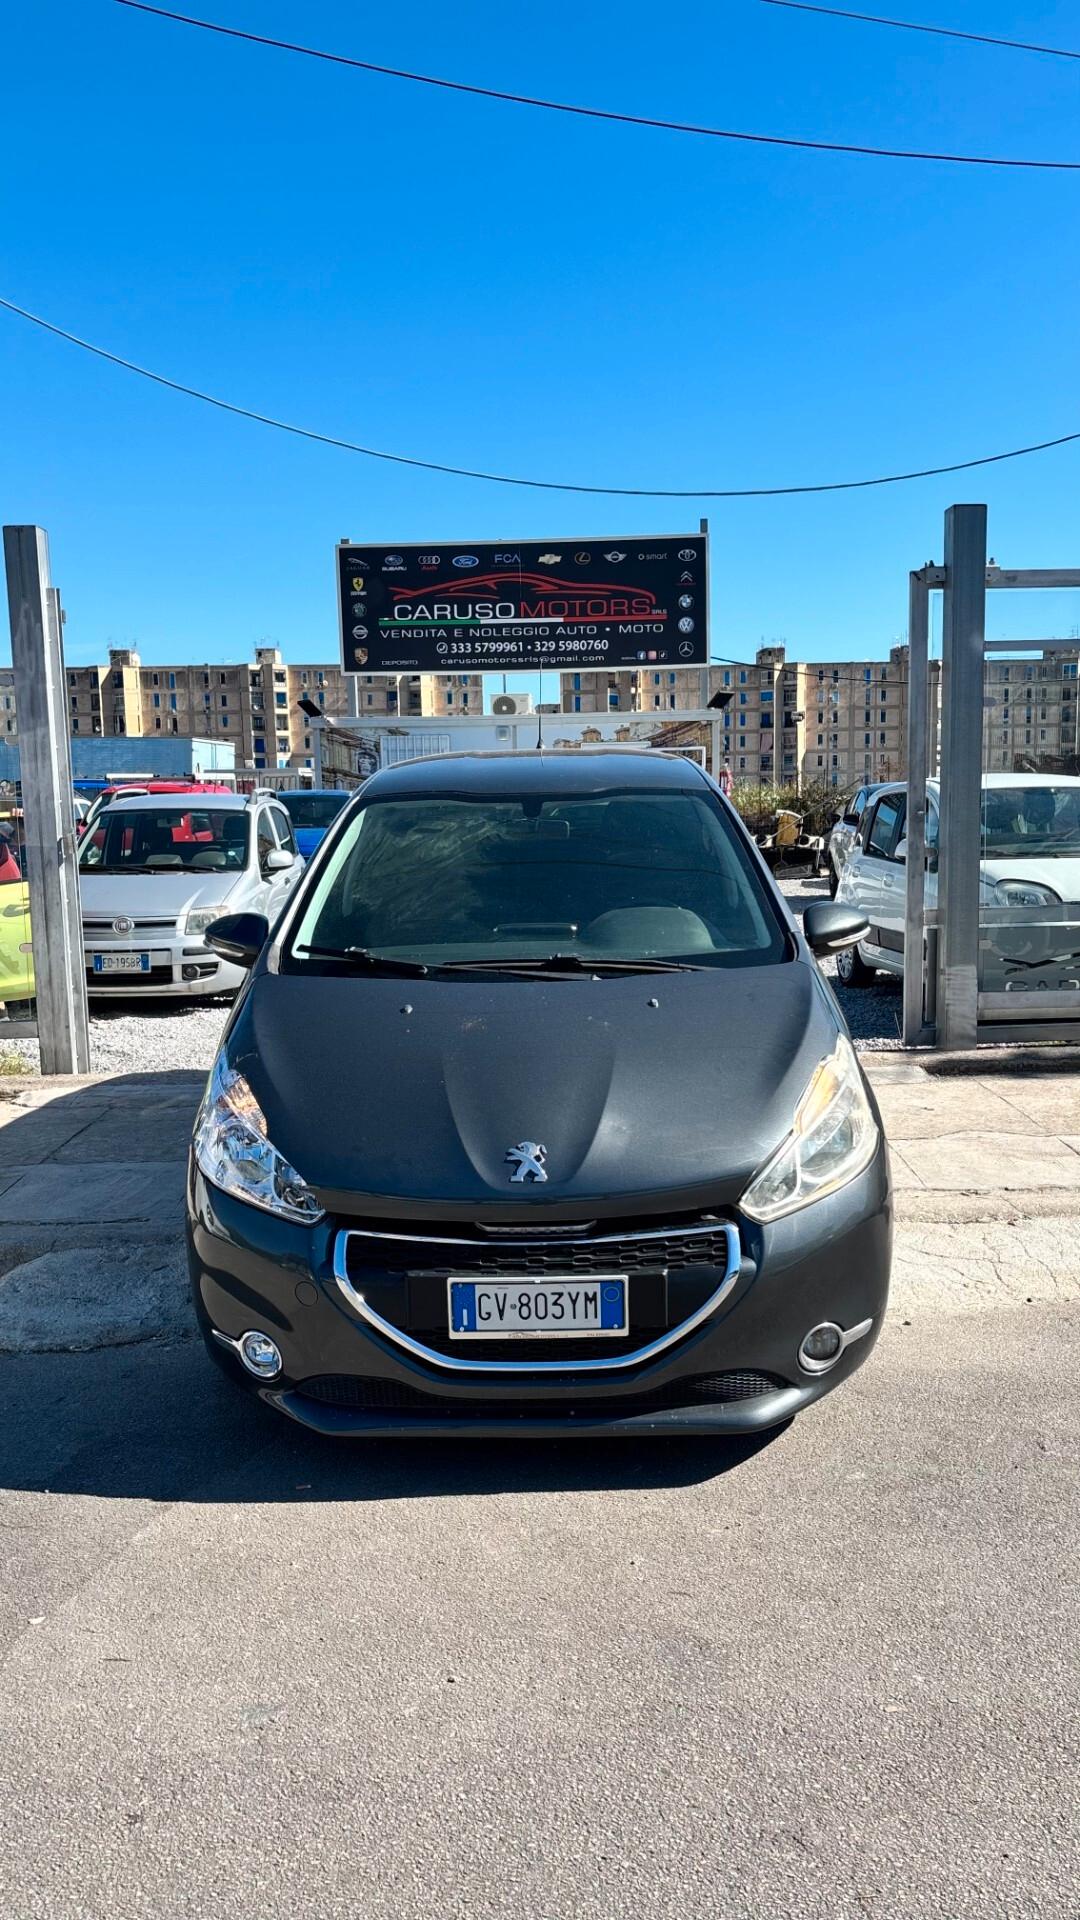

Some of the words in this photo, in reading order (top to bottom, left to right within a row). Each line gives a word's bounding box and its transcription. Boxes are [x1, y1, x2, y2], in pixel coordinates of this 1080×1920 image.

[645, 552, 668, 560] smart
[394, 603, 515, 620] CARUSO
[520, 598, 650, 617] MOTORS
[379, 628, 448, 639] VENDITA
[454, 628, 463, 637] E
[469, 626, 550, 638] NOLEGGIO
[555, 625, 597, 636] AUTO
[618, 623, 664, 634] MOTO
[450, 642, 472, 654] 333
[475, 641, 523, 654] 5799961
[534, 640, 555, 652] 329
[558, 639, 609, 652] 5980760
